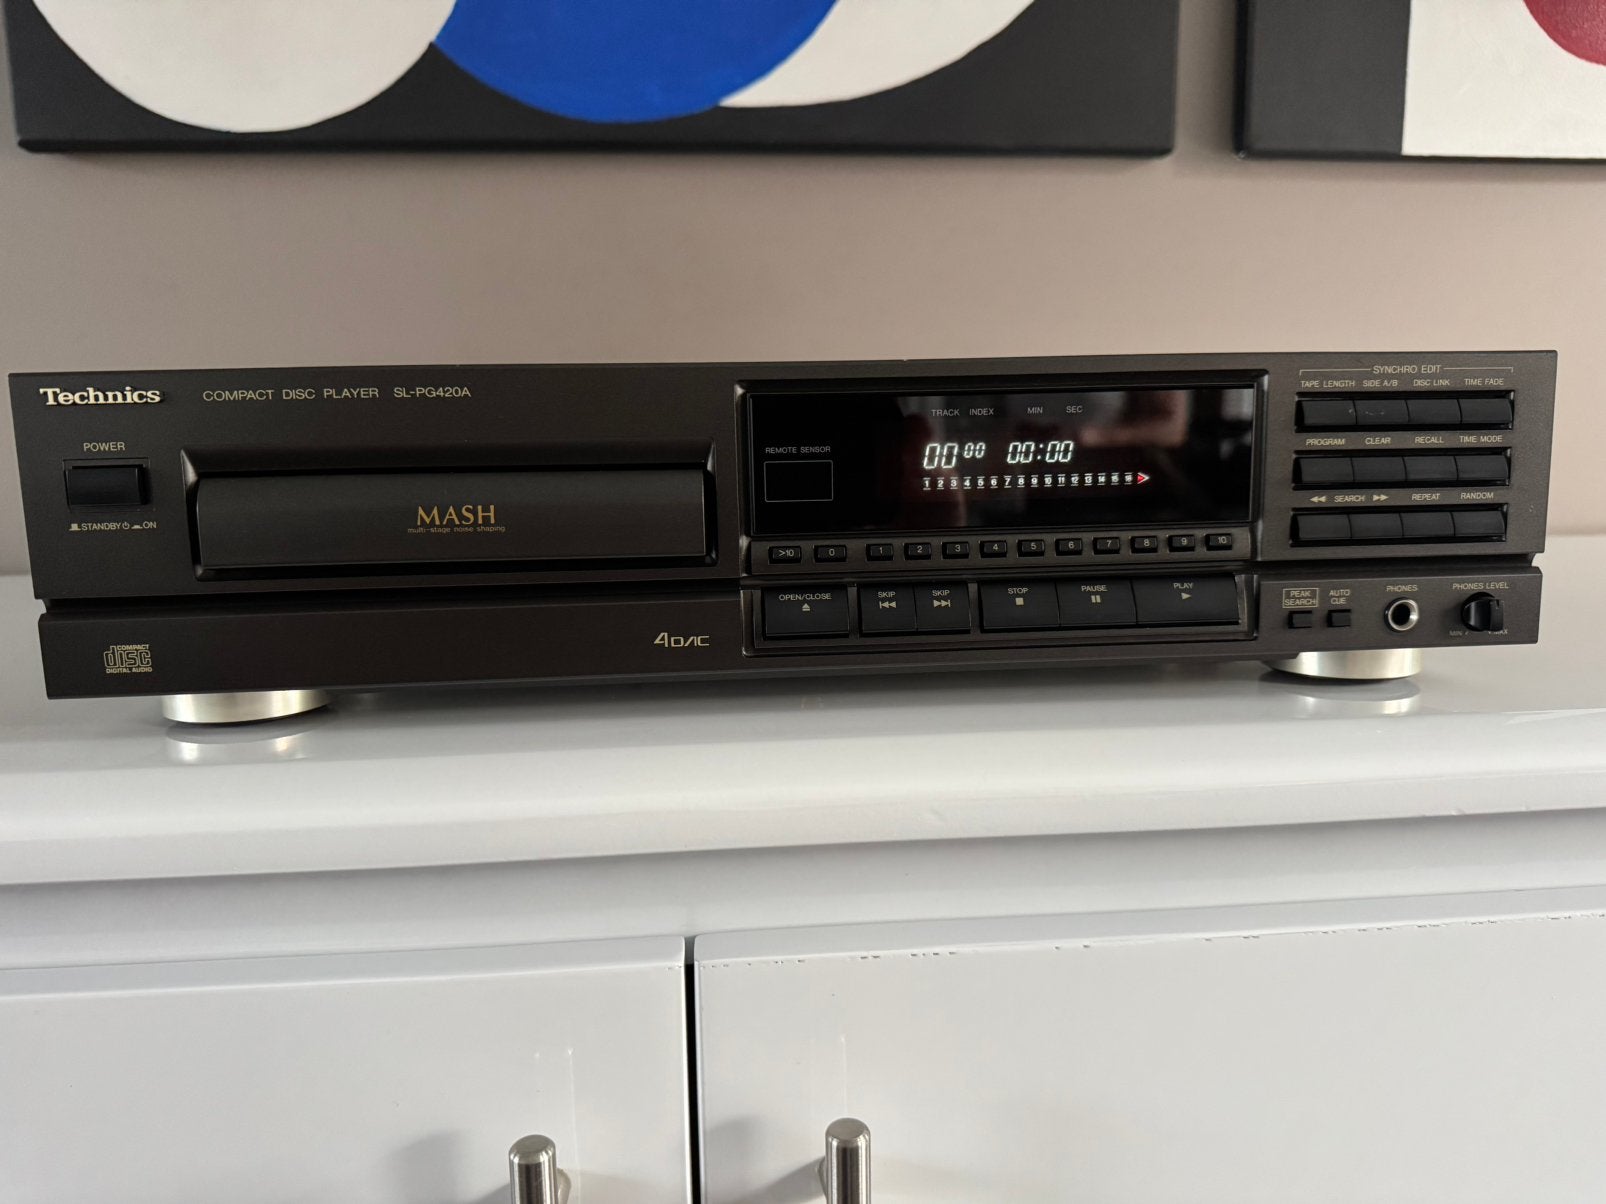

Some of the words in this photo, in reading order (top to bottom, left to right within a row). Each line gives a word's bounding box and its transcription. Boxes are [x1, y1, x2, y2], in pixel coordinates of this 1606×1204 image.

[1373, 364, 1417, 374] SYNCHRO
[1421, 364, 1442, 374] EDIT
[1301, 380, 1319, 388] TAPE
[1323, 379, 1355, 388] LENGTH
[1363, 379, 1380, 387] SIDE
[1383, 379, 1398, 387] A/B
[1413, 379, 1431, 387] DISC
[1433, 378, 1450, 387] LINK
[1464, 378, 1482, 386] TIME
[1485, 378, 1504, 386] FADE
[39, 387, 161, 406] Technics
[203, 390, 274, 401] COMPACT
[282, 389, 315, 400] DISC
[323, 388, 379, 399] PLAYER
[393, 386, 472, 398] SL-PG420A
[932, 409, 960, 417] TRACK
[969, 407, 994, 416] INDEX
[1027, 406, 1043, 414] MIN
[1066, 405, 1083, 413] SEC
[1306, 438, 1345, 446] PROGRAM
[1365, 437, 1391, 445] CLEAR
[1415, 436, 1444, 444] RECALL
[1480, 435, 1503, 443] MODE
[83, 442, 126, 452] POWER
[963, 442, 986, 459] 00
[923, 442, 959, 469] 00
[1006, 440, 1074, 464] 00:00
[1044, 477, 1053, 485] 10
[1057, 477, 1066, 485] 11
[1070, 476, 1080, 484] 12
[1084, 476, 1093, 484] 13
[1335, 495, 1365, 503] SEARCH
[1412, 493, 1440, 501] REPEAT
[1461, 492, 1494, 500] RANDOM
[417, 504, 496, 526] MASH
[81, 522, 121, 531] STANDBY
[143, 521, 157, 530] ON
[476, 525, 506, 533] shaping
[1106, 539, 1112, 548] 7
[1144, 538, 1150, 547] 8
[1181, 537, 1188, 546] 9
[1217, 536, 1227, 544] 10
[955, 544, 961, 552] 3
[993, 543, 999, 551] 4
[1031, 542, 1037, 550] 5
[1068, 540, 1075, 549] 6
[828, 548, 835, 556] 0
[917, 545, 923, 553] 2
[1007, 587, 1029, 595] STOP
[1386, 584, 1418, 592] PHONES
[778, 593, 832, 601] OPEN/CLOSE
[932, 589, 950, 597] SKIP
[1329, 589, 1349, 597] AUTO
[1285, 598, 1316, 606] SEARCH
[1331, 597, 1346, 605] CUE
